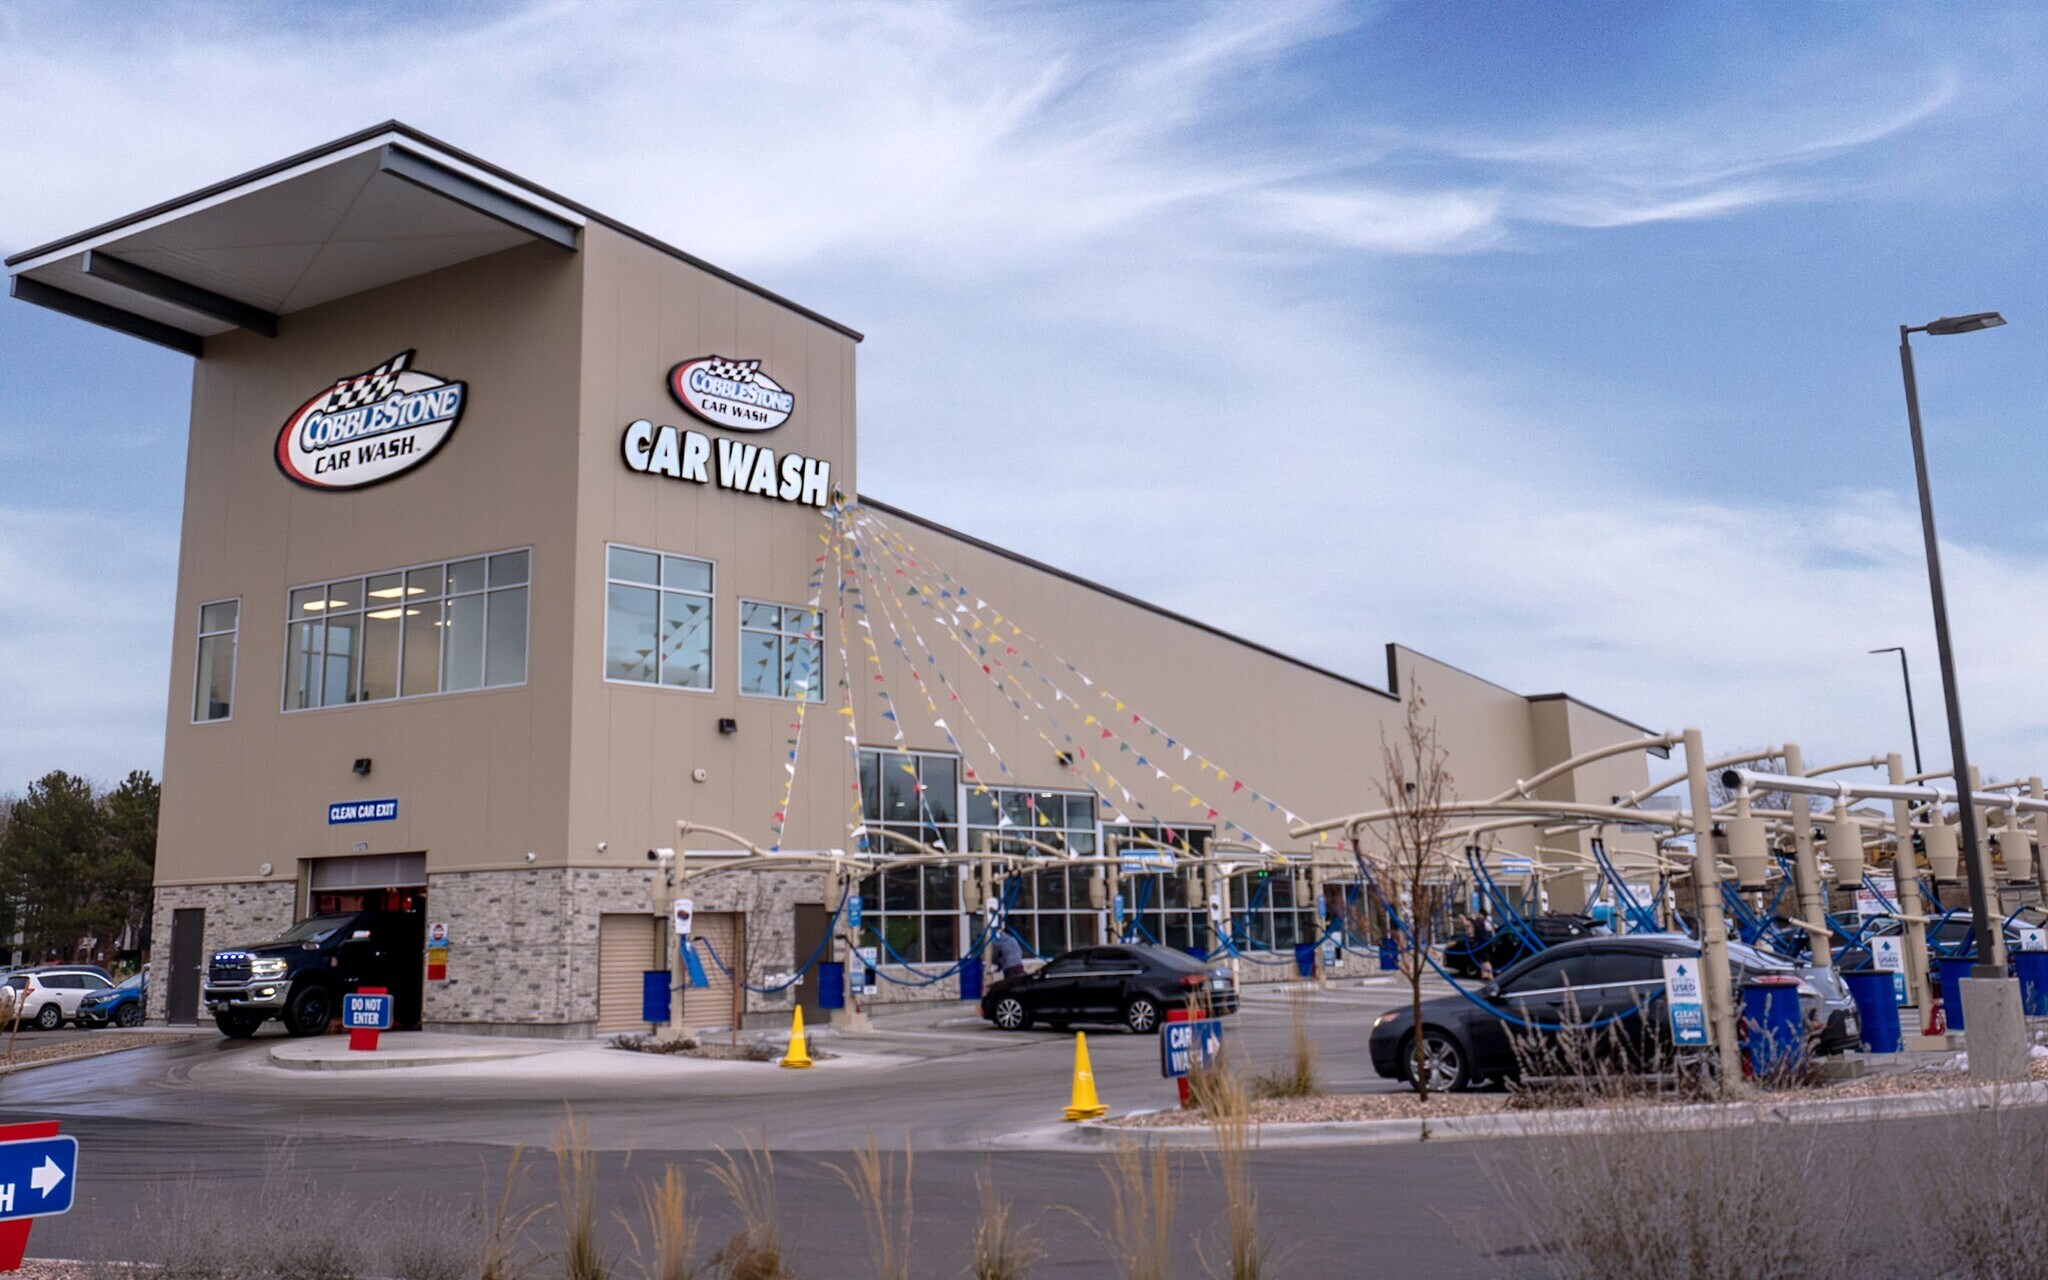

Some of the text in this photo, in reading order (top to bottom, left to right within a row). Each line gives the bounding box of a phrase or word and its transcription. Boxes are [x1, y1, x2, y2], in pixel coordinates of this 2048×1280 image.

[692, 370, 792, 410] COBBLESTONE
[303, 387, 459, 447] COBBLESTONE
[701, 399, 768, 423] CAR WASH
[315, 435, 415, 474] CAR WASH
[624, 418, 831, 507] CAR WASH
[331, 803, 395, 821] CLEAN CAR EXIT
[351, 998, 382, 1011] DO NOT
[353, 1011, 379, 1025] ENTER
[1171, 1026, 1192, 1049] CAR
[1172, 1050, 1204, 1072] WA
